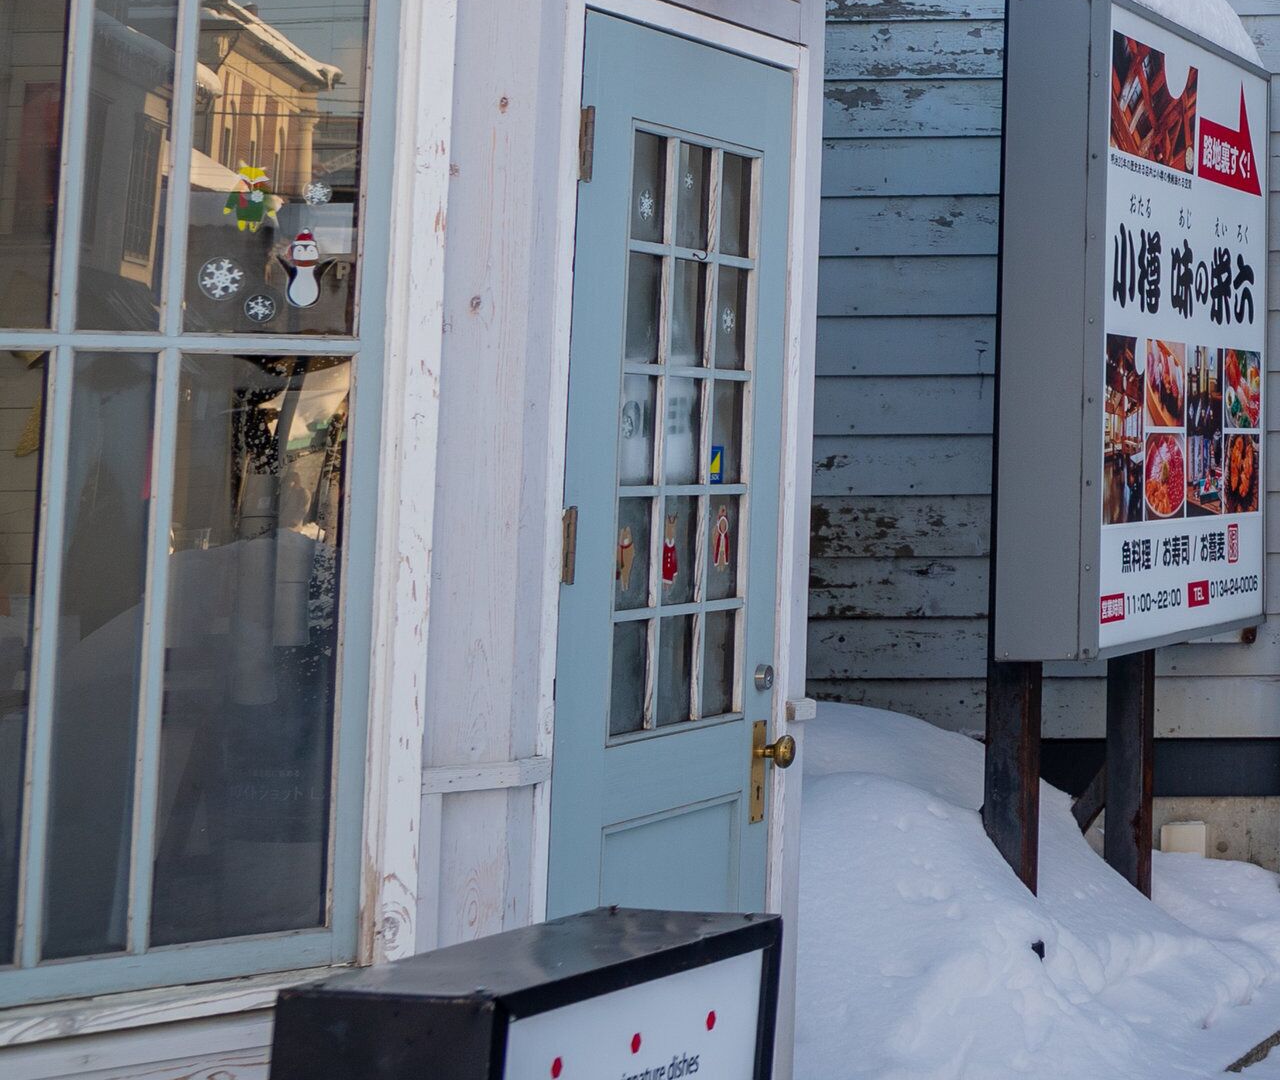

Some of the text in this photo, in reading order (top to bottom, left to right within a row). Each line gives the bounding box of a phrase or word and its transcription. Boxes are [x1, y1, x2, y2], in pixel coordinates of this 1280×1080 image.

[1129, 194, 1152, 219] おたる
[1178, 207, 1192, 229] あじ
[1112, 222, 1162, 314] 小樽
[1121, 538, 1152, 574] 魚料理
[1161, 534, 1190, 568] お寿司
[1199, 530, 1226, 564] お蕎麦
[1101, 596, 1125, 622] 営業時間
[1192, 585, 1205, 603] TEL
[1209, 575, 1259, 599] 0134-24-0006
[667, 1051, 700, 1080] dishes
